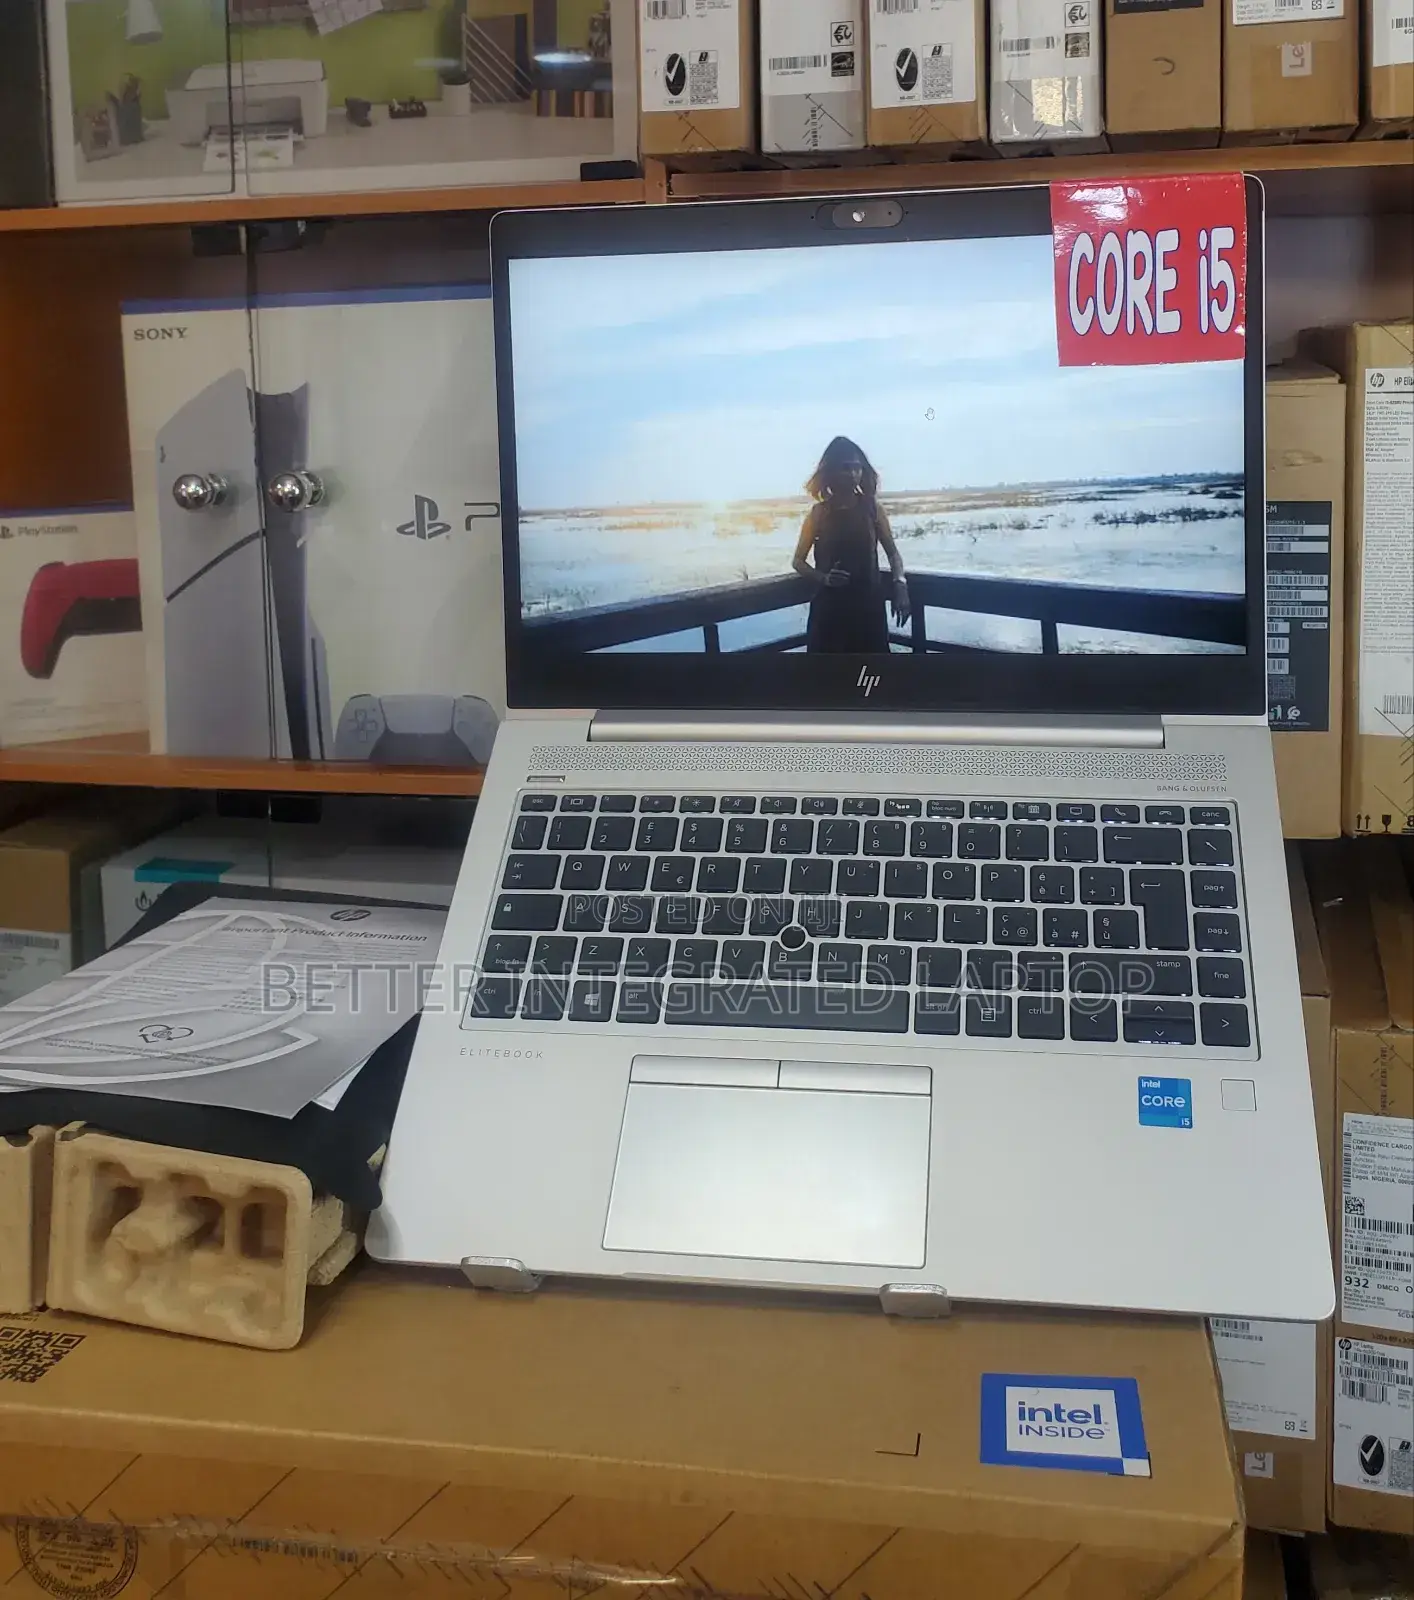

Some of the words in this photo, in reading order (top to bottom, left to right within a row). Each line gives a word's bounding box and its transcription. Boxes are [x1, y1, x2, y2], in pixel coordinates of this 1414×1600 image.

[1068, 228, 1181, 336] CORE
[1199, 226, 1236, 334] i5
[134, 327, 188, 340] SONY
[857, 665, 880, 697] hp
[647, 822, 655, 830] £
[690, 823, 697, 832] $
[735, 823, 745, 832] %
[780, 823, 788, 832] &
[599, 834, 607, 843] 2
[1015, 829, 1022, 838] ?
[644, 835, 651, 844] 3
[688, 836, 696, 844] 4
[734, 836, 741, 845] 5
[780, 837, 787, 846] 6
[825, 838, 833, 847] 7
[872, 840, 880, 848] 8
[919, 841, 927, 850] 9
[572, 861, 583, 871] Q
[618, 862, 631, 872] W
[662, 863, 670, 872] E
[707, 864, 716, 874] R
[753, 865, 761, 874] T
[800, 865, 809, 875] Y
[847, 866, 856, 877] U
[943, 870, 953, 880] O
[990, 871, 999, 881] P
[1203, 884, 1219, 892] pag
[576, 903, 585, 912] A
[621, 904, 629, 913] S
[666, 904, 676, 914] D
[713, 905, 721, 915] F
[760, 906, 770, 916] G
[807, 907, 816, 917] H
[855, 909, 862, 919] J
[904, 911, 913, 921] K
[953, 913, 961, 923] L
[292, 927, 345, 938] Product
[348, 931, 428, 942] Information
[1017, 927, 1028, 937] @
[1071, 931, 1079, 939] #
[1207, 928, 1223, 936] pag
[588, 945, 599, 955] Z
[636, 946, 645, 956] X
[683, 947, 693, 957] C
[731, 948, 741, 958] V
[779, 952, 788, 962] B
[828, 951, 837, 961] N
[878, 953, 889, 964] M
[1156, 960, 1181, 968] stamp
[1214, 971, 1230, 979] fine
[460, 1048, 543, 1058] ELITEBOOK
[1142, 1079, 1160, 1088] intel
[1182, 1118, 1190, 1126] i5
[1352, 1139, 1390, 1148] CONFIDENCE
[1344, 1276, 1369, 1288] 932
[1377, 1284, 1399, 1292] DMCQ
